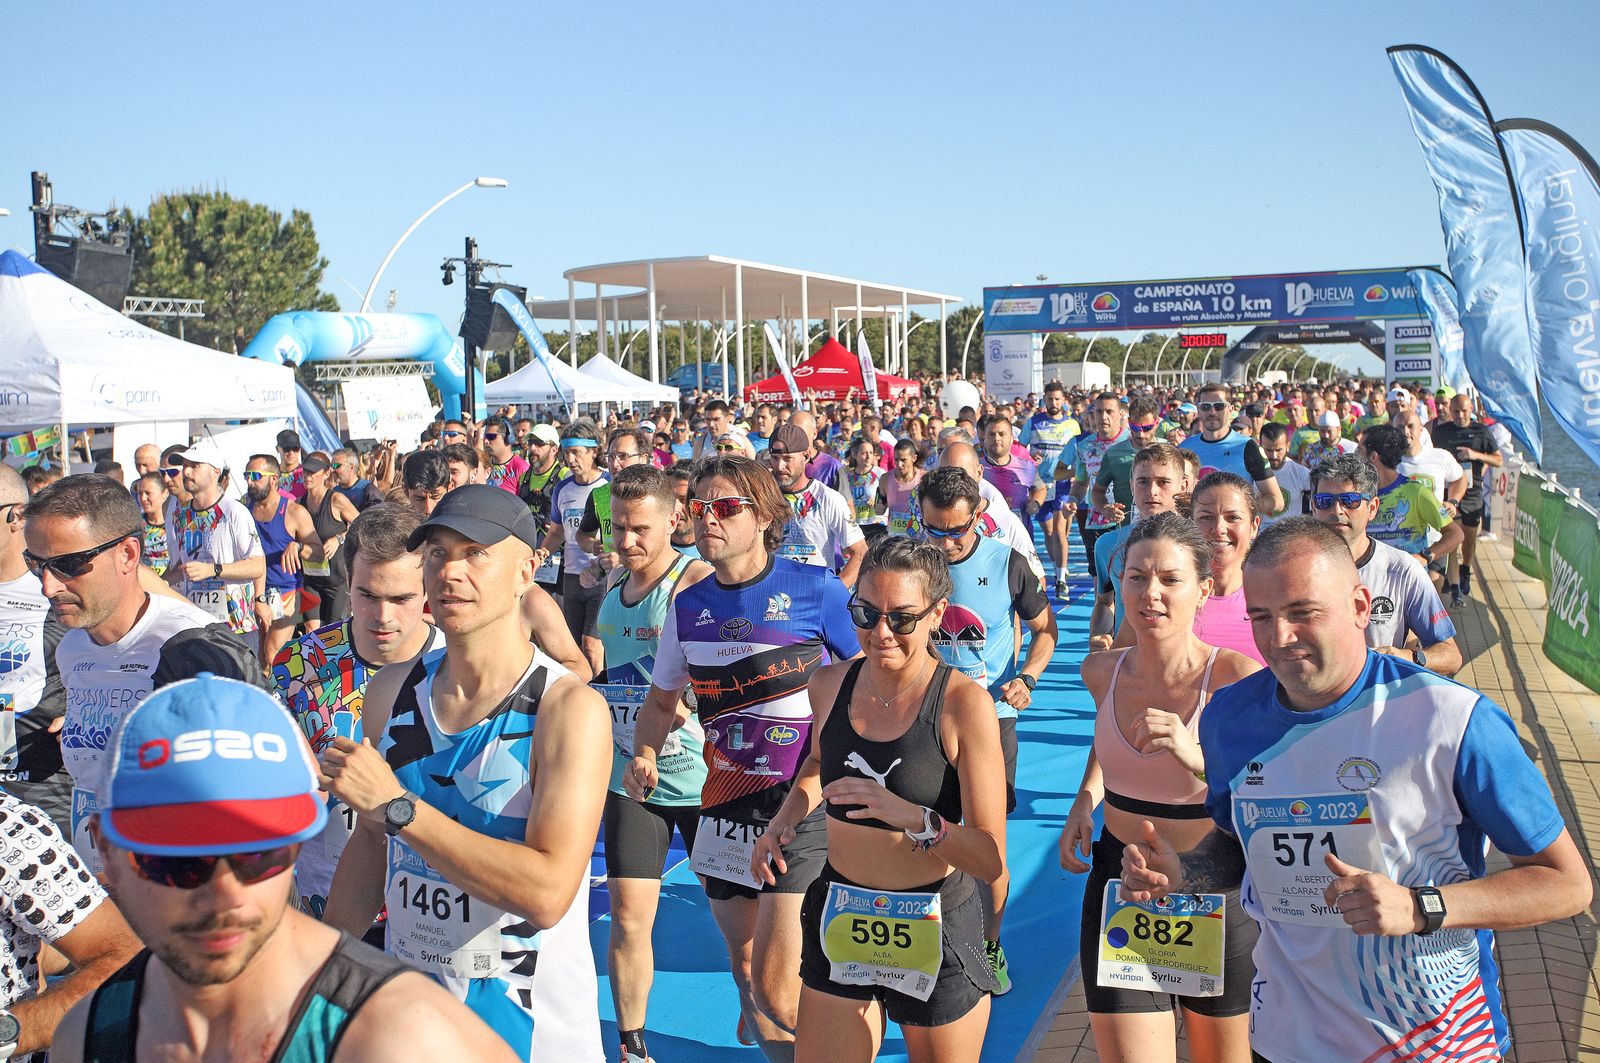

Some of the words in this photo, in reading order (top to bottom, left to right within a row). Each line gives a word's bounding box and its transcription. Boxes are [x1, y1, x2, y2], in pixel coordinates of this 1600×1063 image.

[1134, 283, 1235, 298] CAMPEONATO
[1311, 286, 1354, 300] HUELVA
[1134, 303, 1149, 313] de
[1153, 298, 1203, 312] ESPAÑA
[1212, 296, 1234, 312] 10
[1241, 294, 1272, 311] km
[1201, 312, 1234, 320] Absoluto
[1244, 311, 1272, 319] Master
[191, 592, 219, 604] 1712
[717, 645, 754, 658] HUELVA
[660, 756, 694, 768] Academia
[662, 764, 695, 774] Machado
[1257, 806, 1288, 818] HUELVA
[1318, 802, 1358, 820] 2023
[1273, 832, 1340, 867] 571
[403, 853, 423, 867] HUELVA
[1295, 875, 1334, 884] ALBERTO
[1282, 886, 1319, 895] ALCARAZ
[398, 876, 470, 923] 1461
[848, 896, 870, 908] HUELVA
[897, 901, 929, 915] 2023
[1181, 900, 1213, 913] 2023
[1272, 906, 1305, 917] HYUNDAI
[416, 922, 446, 936] MANUEL
[851, 918, 912, 949] 595
[1133, 913, 1194, 946] 882
[410, 931, 438, 946] PAREJO
[440, 939, 453, 948] GIL
[1115, 953, 1162, 966] DOMINGUEZ
[1148, 948, 1177, 958] GLORIA
[868, 959, 899, 968] ANGULO
[1109, 973, 1144, 982] HYUNDAI
